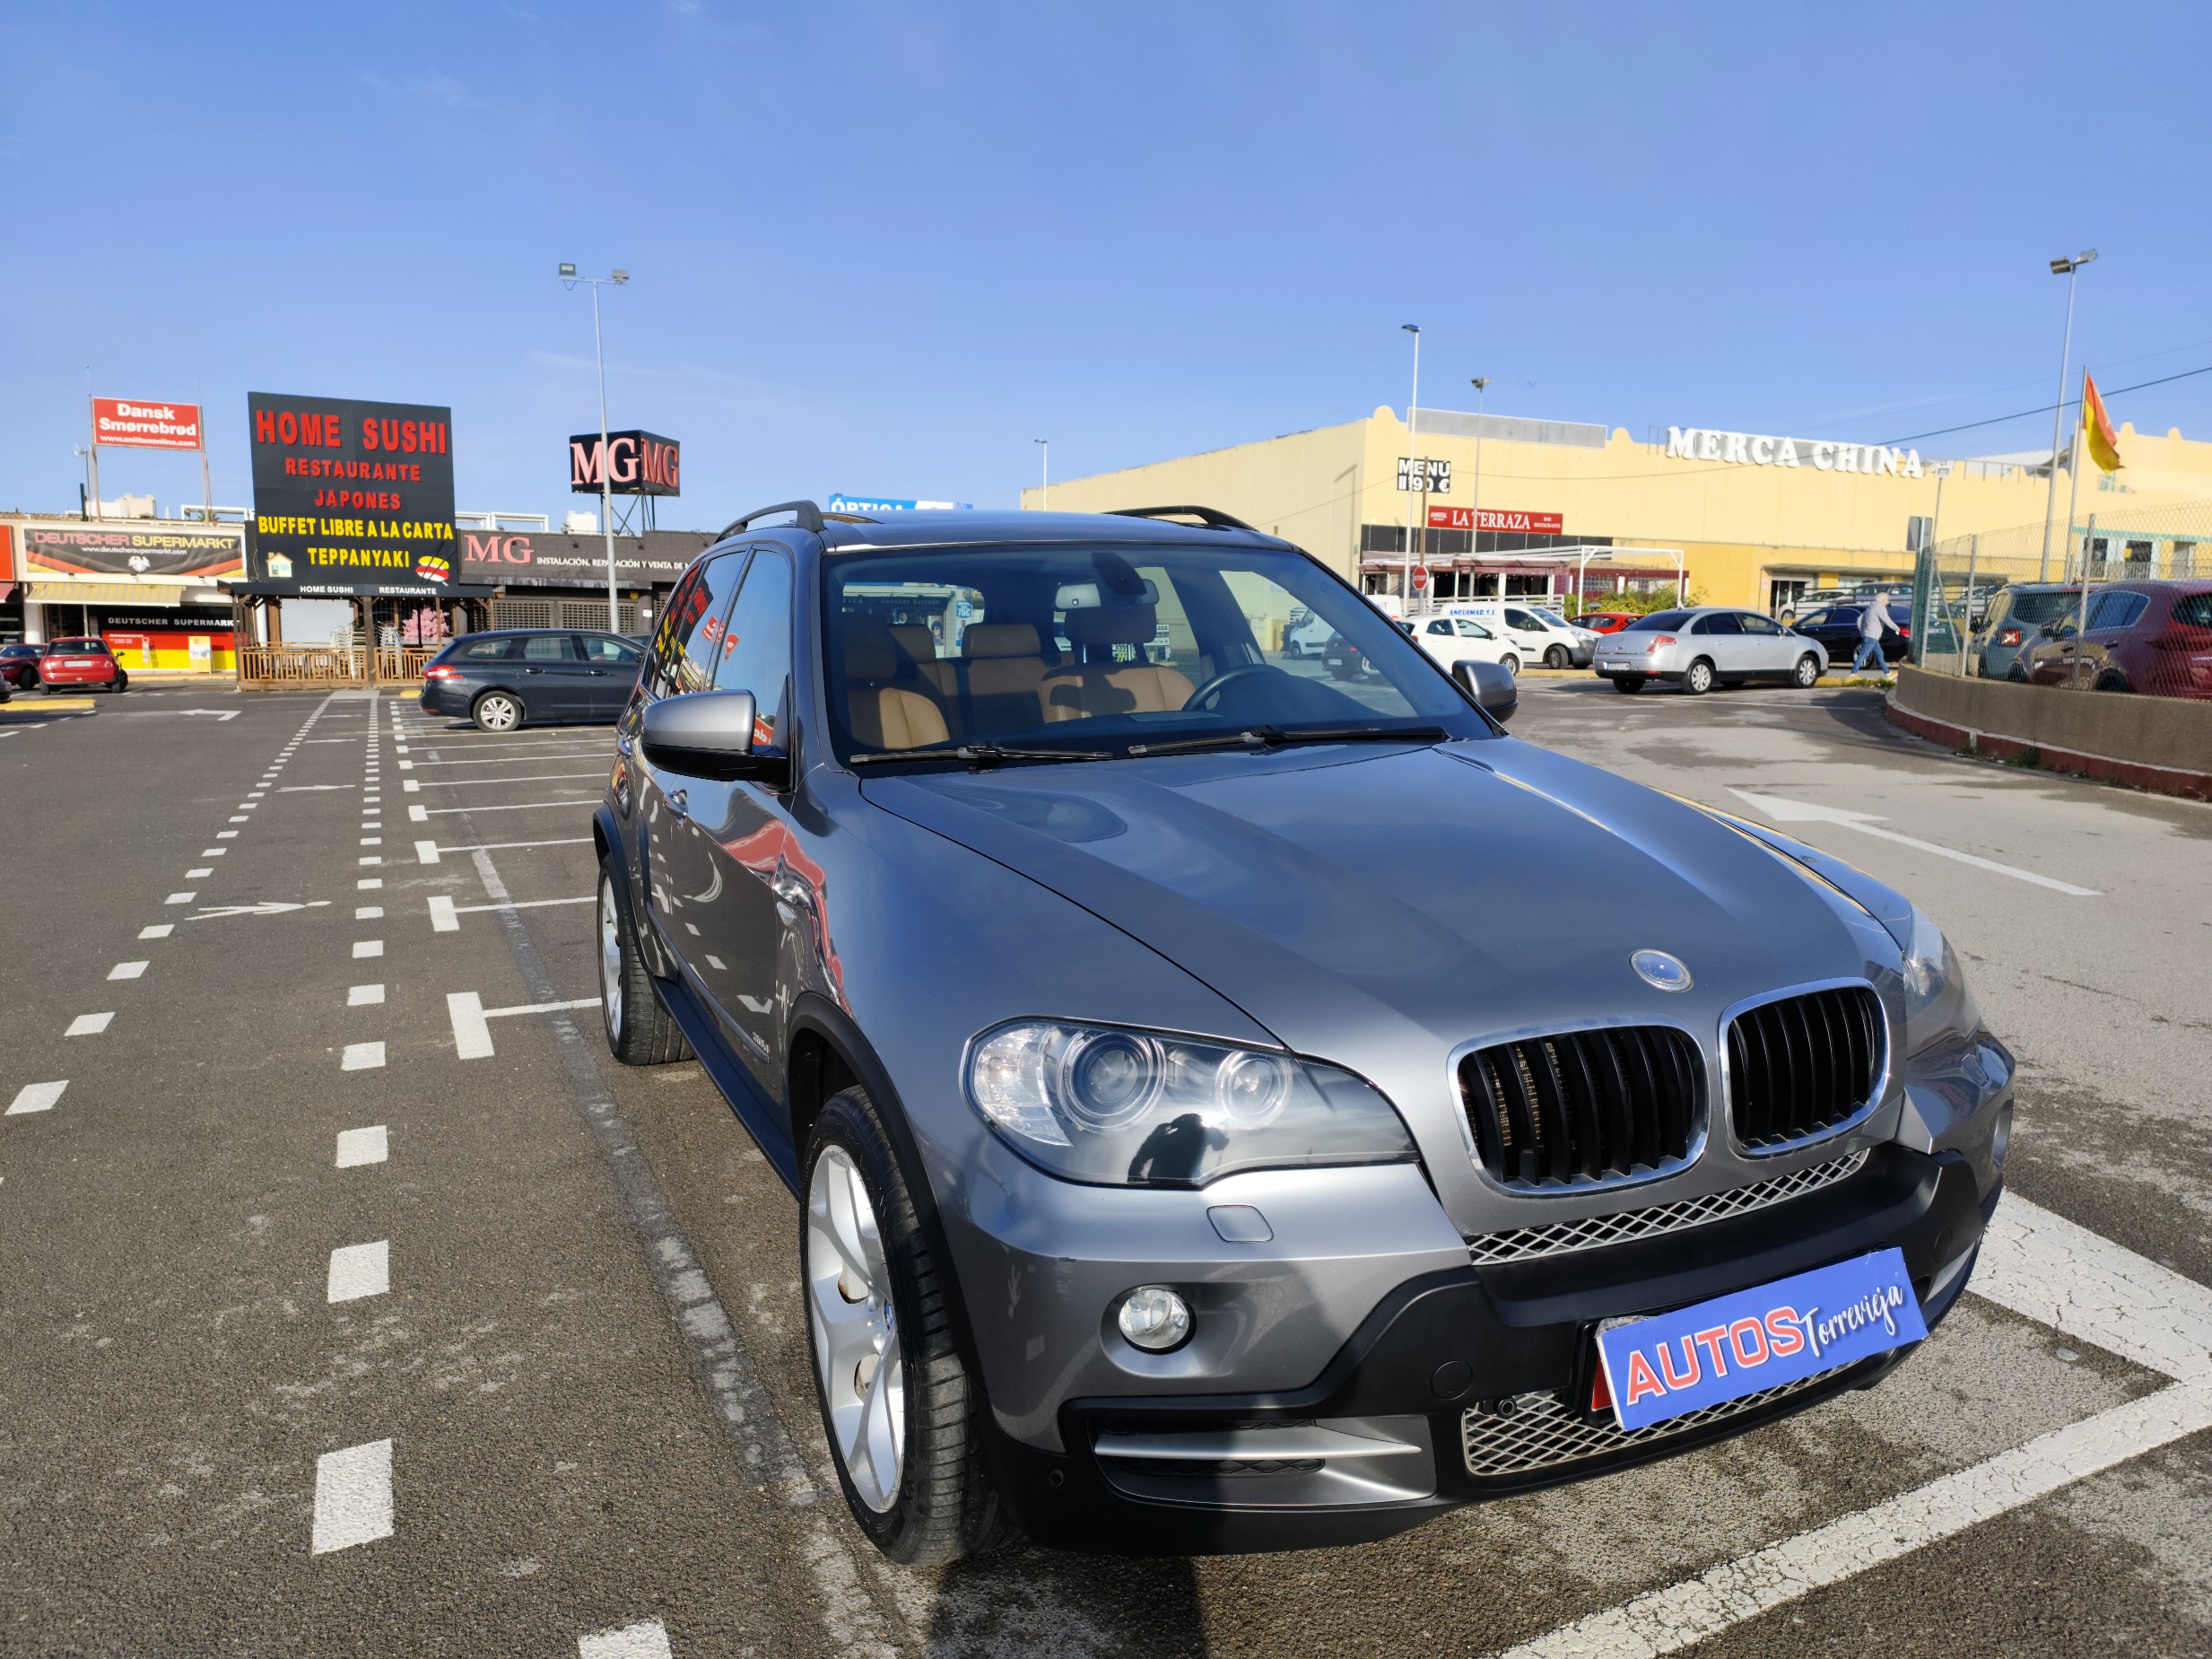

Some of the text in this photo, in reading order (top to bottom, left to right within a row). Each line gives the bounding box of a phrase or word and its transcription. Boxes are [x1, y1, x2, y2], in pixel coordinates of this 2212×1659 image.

[118, 403, 175, 420] Dansk
[100, 417, 196, 436] Smørrebrød
[256, 410, 446, 454] HOME SUSHI
[100, 436, 196, 447] www.snittenonline.com
[570, 437, 640, 485] MG
[640, 438, 679, 487] MG
[1666, 426, 1924, 479] MERCA CHINA
[285, 458, 421, 482] RESTAURANTE
[315, 489, 401, 510] JAPONES
[258, 516, 453, 539] BUFFET LIBRE A LA CARTA
[1452, 510, 1469, 526] LA
[34, 532, 234, 549] DEUTSCHER SUPERMARKT
[82, 546, 187, 555] www.deutschersupermarkt.com
[464, 534, 535, 563] MG
[308, 547, 409, 567] TEPPANYAKI
[592, 558, 640, 568] REPAACIÓN
[648, 561, 672, 569] VENTA
[674, 562, 684, 570] DE
[300, 585, 437, 595] HOME SUSHI RESTAURANTE
[108, 617, 239, 627] DEUTSCHER SUPERMARK
[1626, 1283, 1903, 1406] AUTOS Torrevieja
